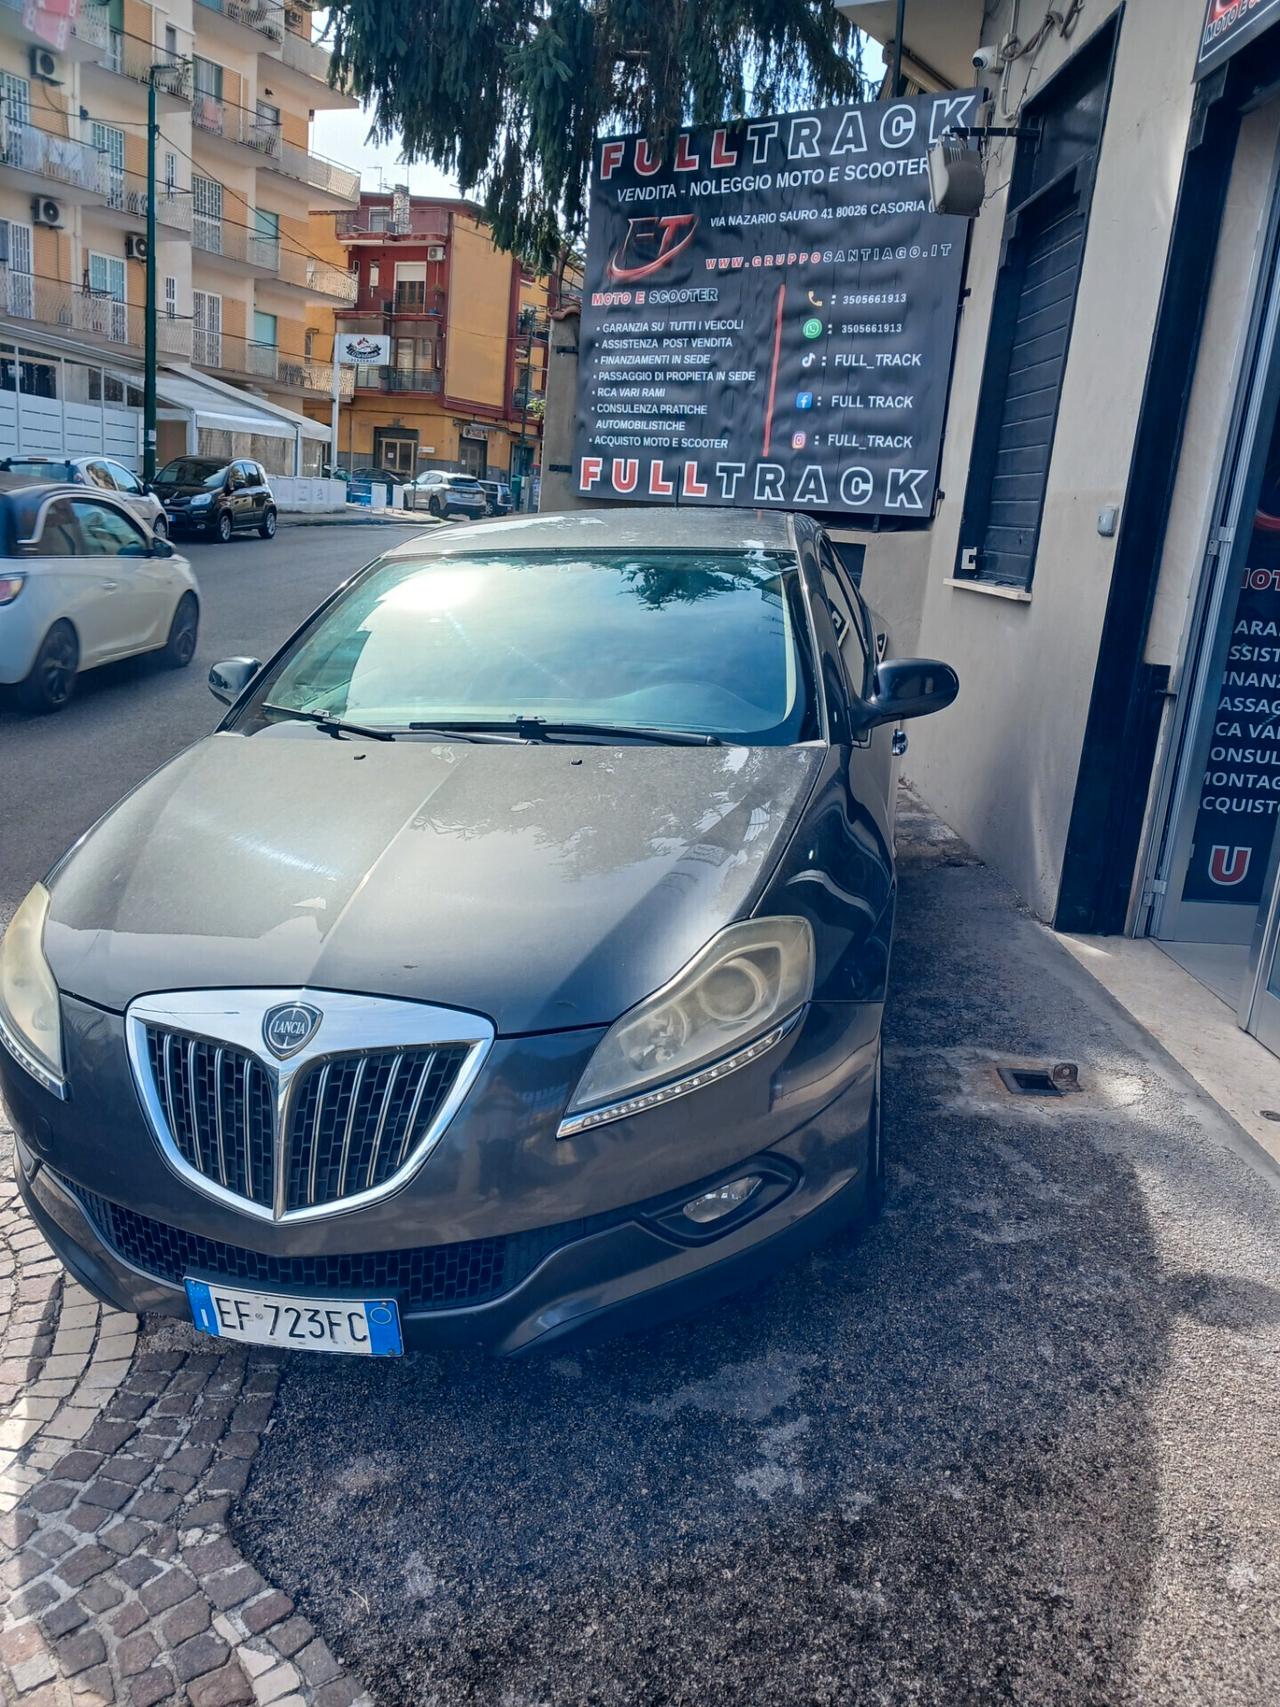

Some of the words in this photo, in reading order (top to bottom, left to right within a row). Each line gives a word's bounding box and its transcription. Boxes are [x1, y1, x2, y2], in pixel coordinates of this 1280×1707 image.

[616, 184, 677, 203] VENDITA
[690, 174, 771, 197] NOLEGGIO
[776, 168, 824, 188] MOTO
[829, 167, 839, 182] E
[844, 157, 929, 180] SCOOTER
[710, 217, 726, 227] VIA
[728, 213, 777, 226] NAZARIO
[779, 209, 819, 223] SAURO
[821, 208, 834, 219] 41
[835, 205, 867, 218] 80026
[870, 200, 925, 216] CASORIA
[706, 243, 952, 270] WWW.GRUPPOSANTIAGO.IT
[592, 292, 631, 306] MOTO
[635, 291, 645, 304] E
[649, 288, 718, 304] SCOOTER
[842, 293, 907, 305] 3505661913
[602, 322, 648, 333] GARANZIA
[651, 322, 664, 331] SU
[670, 321, 696, 331] TUTTI
[698, 320, 702, 331] I
[704, 319, 744, 330] VEICOLI
[841, 323, 903, 334] 3505661913
[601, 338, 658, 349] ASSISTENZA
[663, 338, 688, 348] POST
[691, 337, 733, 348] VENDITA
[600, 355, 669, 364] FINANZIAMENTI
[672, 355, 682, 364] IN
[683, 354, 711, 364] SEDE
[834, 354, 922, 369] FULL_TRACK
[598, 371, 652, 381] PASSAGGIO
[655, 371, 664, 381] DI
[666, 371, 714, 381] PROPIETA
[716, 371, 725, 381] IN
[728, 371, 756, 381] SEDE
[597, 387, 617, 397] RCA
[619, 387, 640, 397] VARI
[642, 387, 666, 397] RAMI
[597, 404, 658, 414] CONSULENZA
[660, 404, 708, 414] PRATICHE
[831, 396, 864, 408] FULL
[867, 396, 914, 408] TRACK
[596, 420, 686, 431] AUTOMOBILISTICHE
[594, 436, 641, 447] ACQUISTO
[643, 437, 670, 447] MOTO
[672, 437, 679, 447] E
[681, 438, 728, 449] SCOOTER
[827, 434, 913, 449] FULL_TRACK
[1234, 620, 1280, 637] ARA
[1222, 671, 1280, 689] INAN
[1249, 724, 1280, 740] VA
[1202, 796, 1280, 814] CQUIST
[1208, 845, 1252, 886] U
[274, 1020, 305, 1034] LANCIA
[214, 1296, 250, 1331] EF
[263, 1304, 368, 1343] 723FC
